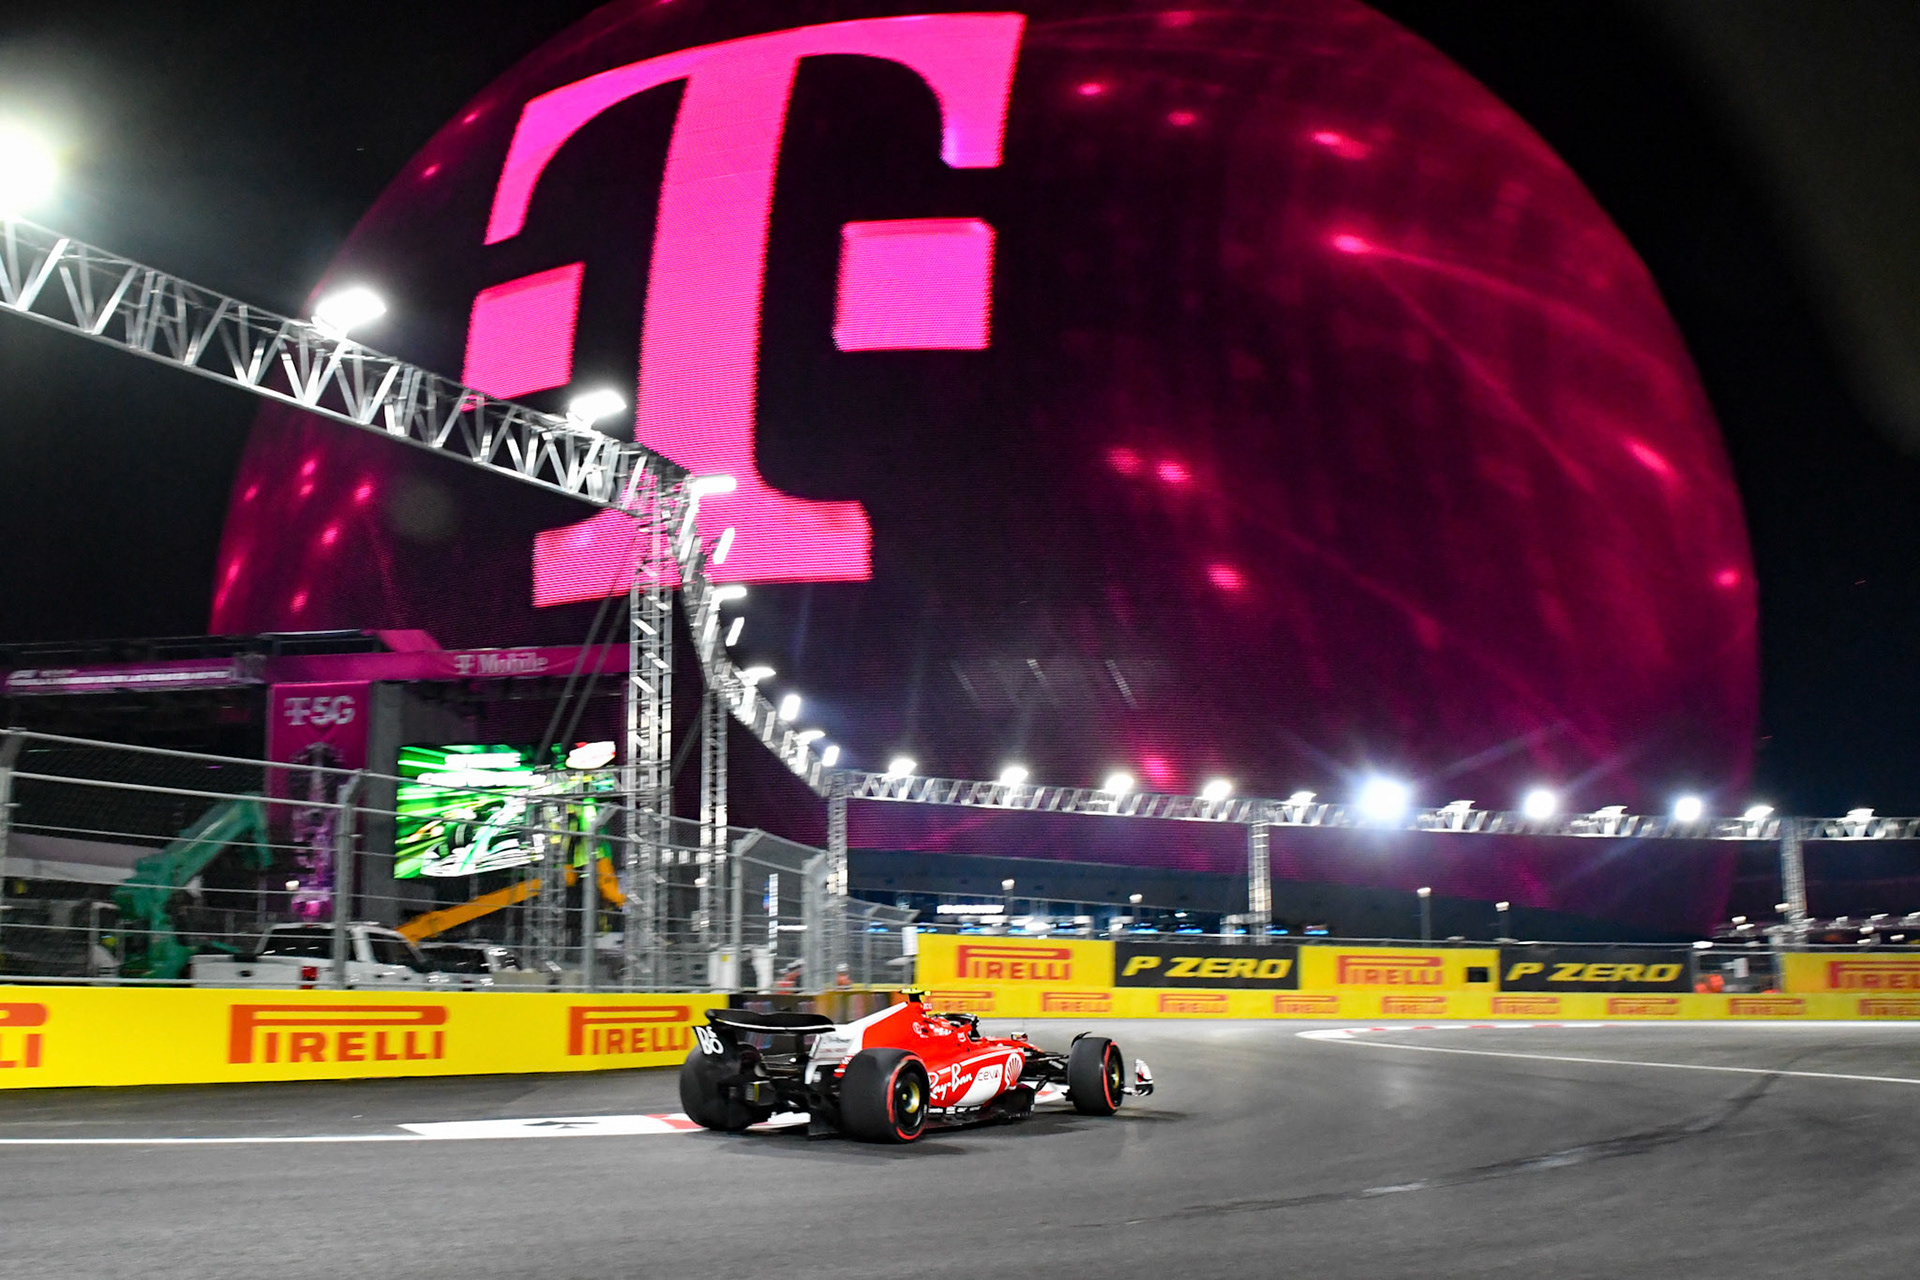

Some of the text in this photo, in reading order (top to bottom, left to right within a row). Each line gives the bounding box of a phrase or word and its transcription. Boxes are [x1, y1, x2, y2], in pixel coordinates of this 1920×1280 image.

[954, 944, 1073, 981] PIRELLI
[1121, 955, 1293, 979] P ZERO
[1335, 955, 1444, 985] PIRELLI
[1504, 962, 1684, 982] P ZERO
[227, 1004, 449, 1065] PIRELLI
[567, 1005, 692, 1056] PIRELLI
